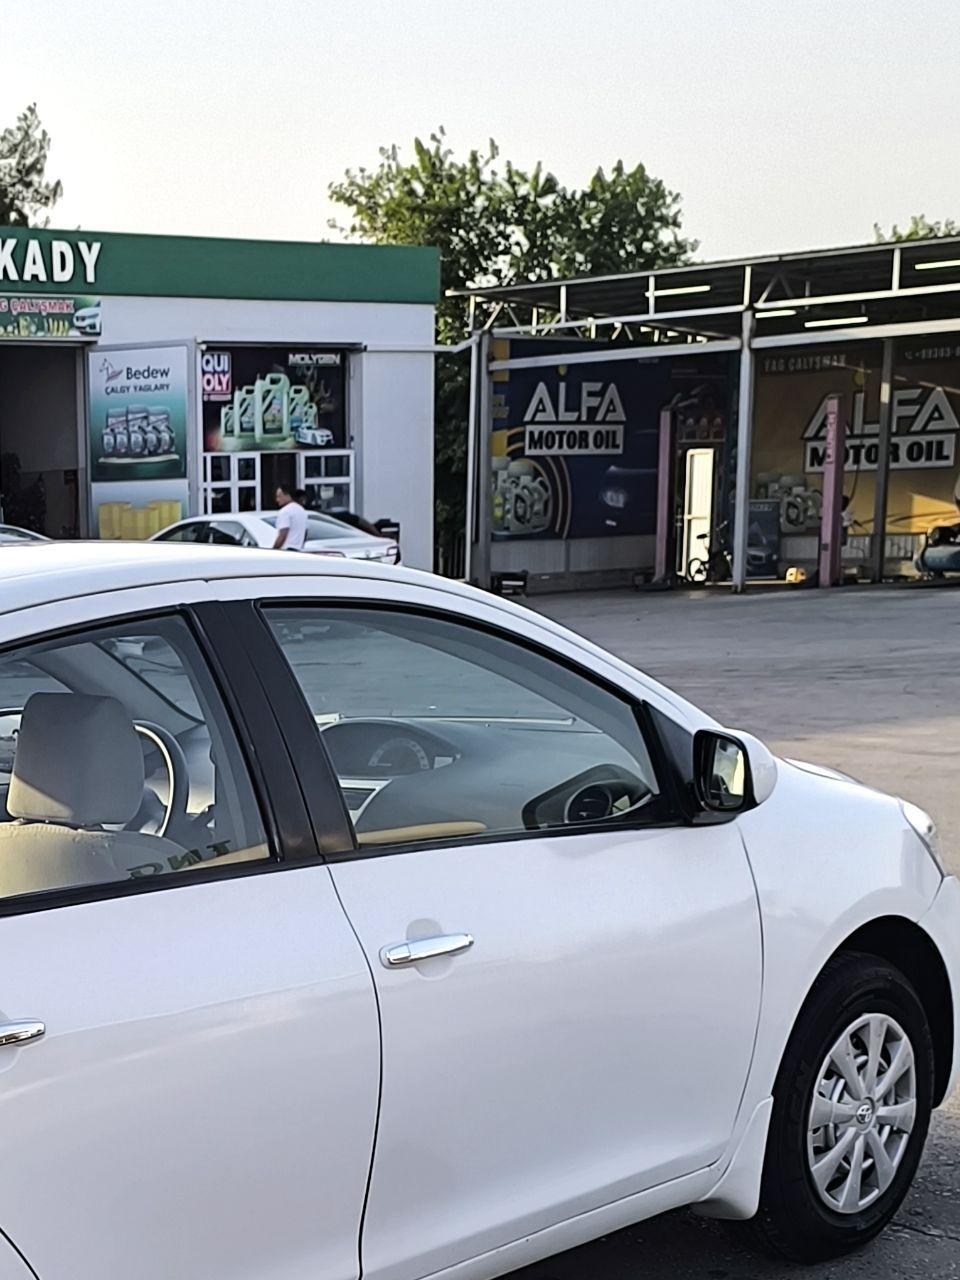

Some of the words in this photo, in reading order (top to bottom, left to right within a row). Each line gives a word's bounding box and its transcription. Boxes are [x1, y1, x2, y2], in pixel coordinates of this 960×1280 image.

[126, 365, 170, 380] Bedew
[523, 381, 627, 422] ALFA
[528, 430, 589, 450] MOTOR
[593, 430, 620, 449] OIL
[809, 443, 900, 467] MTOR
[906, 440, 950, 463] OIL
